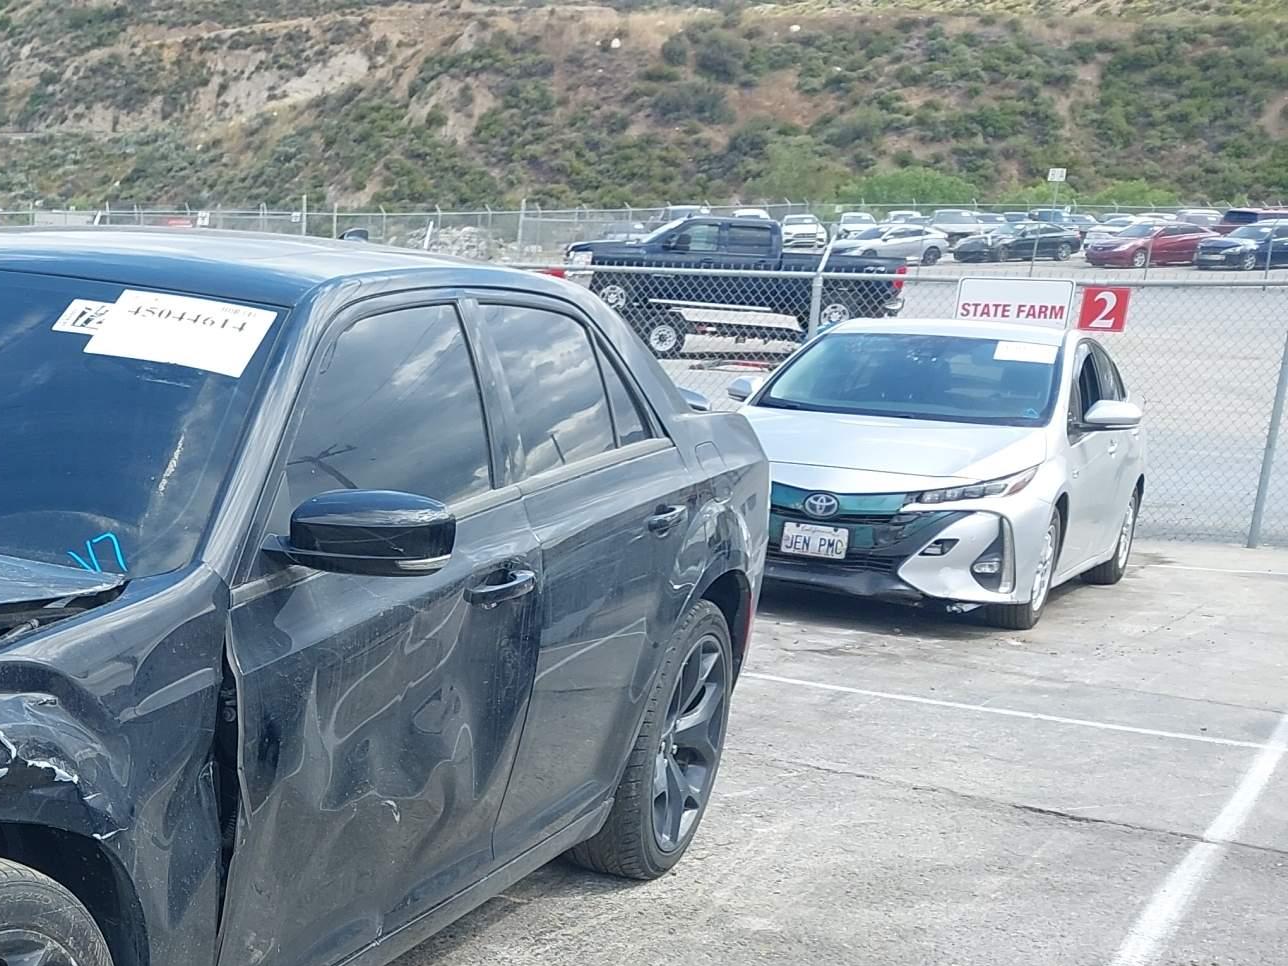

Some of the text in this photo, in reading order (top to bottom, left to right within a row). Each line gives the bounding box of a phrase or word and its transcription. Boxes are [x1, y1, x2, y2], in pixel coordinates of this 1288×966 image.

[960, 302, 1065, 320] STATE FARM
[1088, 290, 1118, 329] 2
[785, 534, 844, 555] JEN PMC
